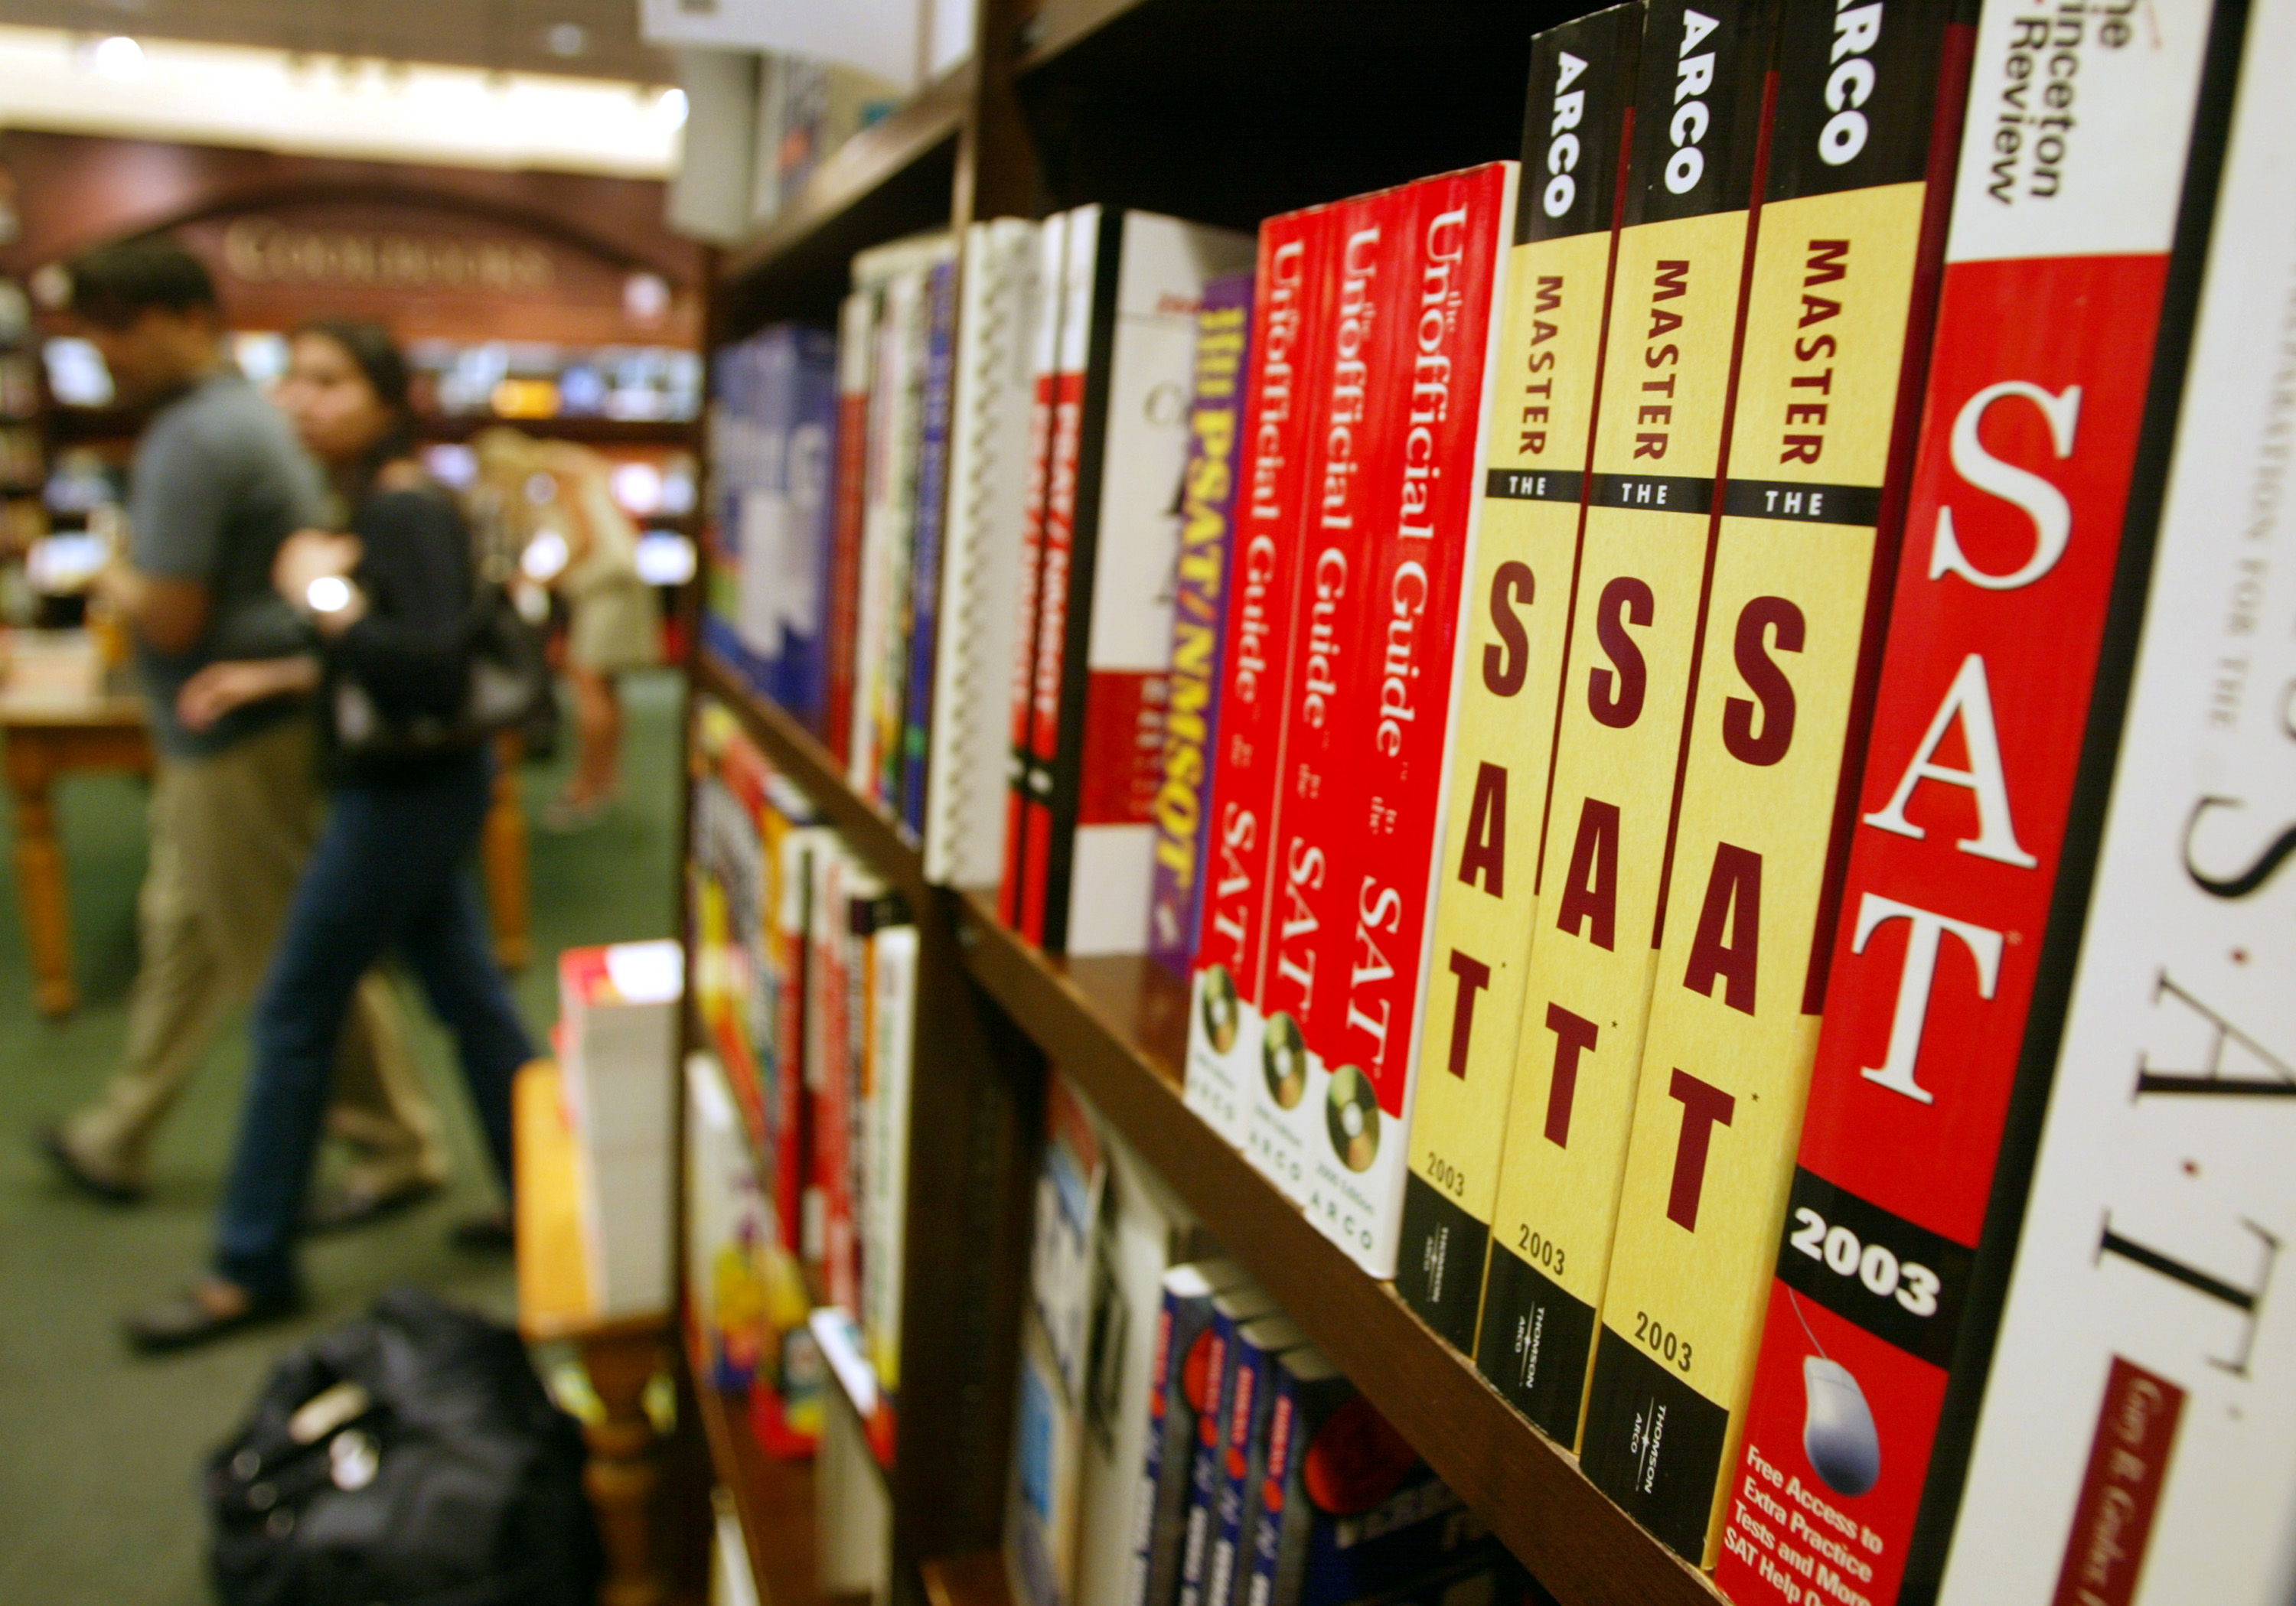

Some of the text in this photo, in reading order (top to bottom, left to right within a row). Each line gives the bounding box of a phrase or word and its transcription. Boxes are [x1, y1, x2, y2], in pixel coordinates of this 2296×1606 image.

[1543, 50, 1589, 218] ARCO
[1664, 9, 1720, 194] ARCO
[1817, 0, 1883, 166] RCO
[1987, 16, 2050, 205] Review
[2030, 2, 2097, 198] inceton
[1251, 239, 1303, 520] Unofficial
[1320, 226, 1379, 529] Unofficial
[1397, 202, 1466, 539] Unofficial
[1518, 275, 1564, 455] MASTER
[1633, 260, 1690, 461] MASTER
[1779, 239, 1850, 465] MASTER
[1509, 476, 1546, 496] THE
[1622, 483, 1668, 505] THE
[1765, 490, 1823, 516] THE
[1236, 534, 1275, 704] Guide
[1303, 546, 1347, 729] Guide
[1377, 561, 1428, 757] Guide
[1448, 560, 1535, 1081] SAT
[1851, 380, 2081, 1105] SAT
[1213, 800, 1257, 964] SAT
[1277, 836, 1326, 1010] SAT
[1544, 576, 1654, 1149] SAT
[1666, 595, 1805, 1233] SAT
[1347, 875, 1401, 1065] SAT
[1309, 1190, 1373, 1250] ARCO
[1427, 1152, 1465, 1197] 2003
[1518, 1223, 1565, 1276] 2003
[1515, 1315, 1525, 1354] ARCO
[1634, 1311, 1693, 1373] 2003
[1789, 1207, 1942, 1318] 2003
[1526, 1305, 1545, 1389] THOMSON
[1629, 1412, 1643, 1454] ARCO
[1644, 1405, 1667, 1494] THOMSON
[1746, 1443, 1883, 1555] Free Access to
[1724, 1526, 1759, 1567] SAT
[1759, 1555, 1801, 1604] Help
[1734, 1498, 1776, 1550] Tests
[1777, 1541, 1815, 1578] and
[1743, 1474, 1873, 1583] Extra Practice
